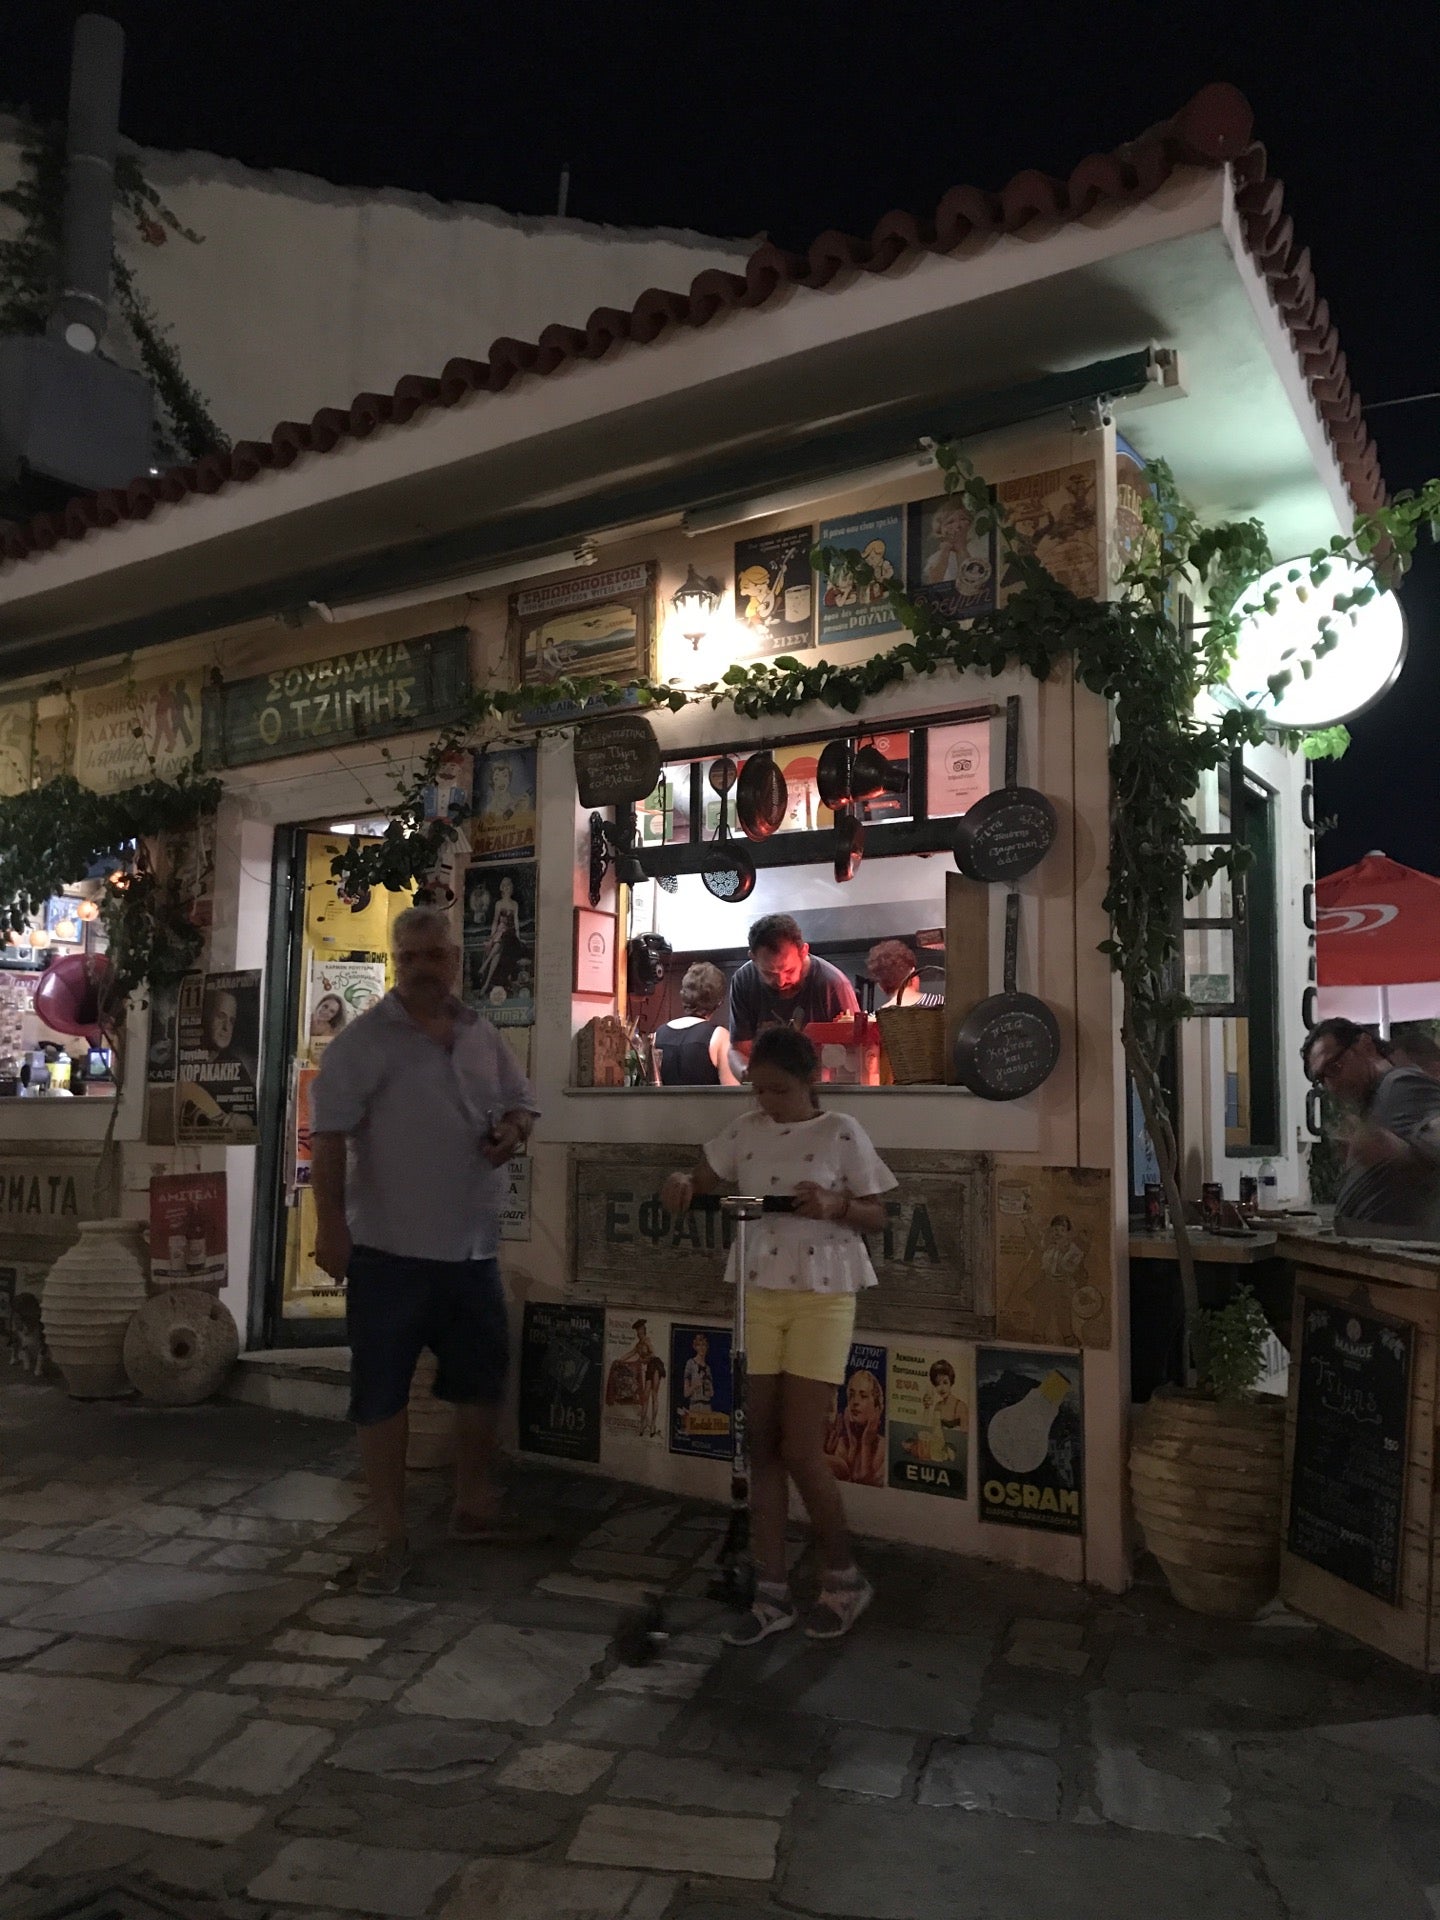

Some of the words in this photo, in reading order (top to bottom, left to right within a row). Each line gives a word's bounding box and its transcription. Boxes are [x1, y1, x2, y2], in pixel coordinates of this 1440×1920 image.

[266, 641, 411, 702] ΣΟΥΒΛΑΚΙΑ
[260, 707, 281, 745] Ο
[290, 676, 419, 738] ΤΖΙΜΗΣ
[179, 1062, 242, 1082] ΚΟΡΑΚΑΚΗΣ
[0, 1175, 78, 1216] ΜΑΤΑ
[905, 1463, 951, 1488] ΕΨΑ
[983, 1479, 1080, 1516] OSRAM
